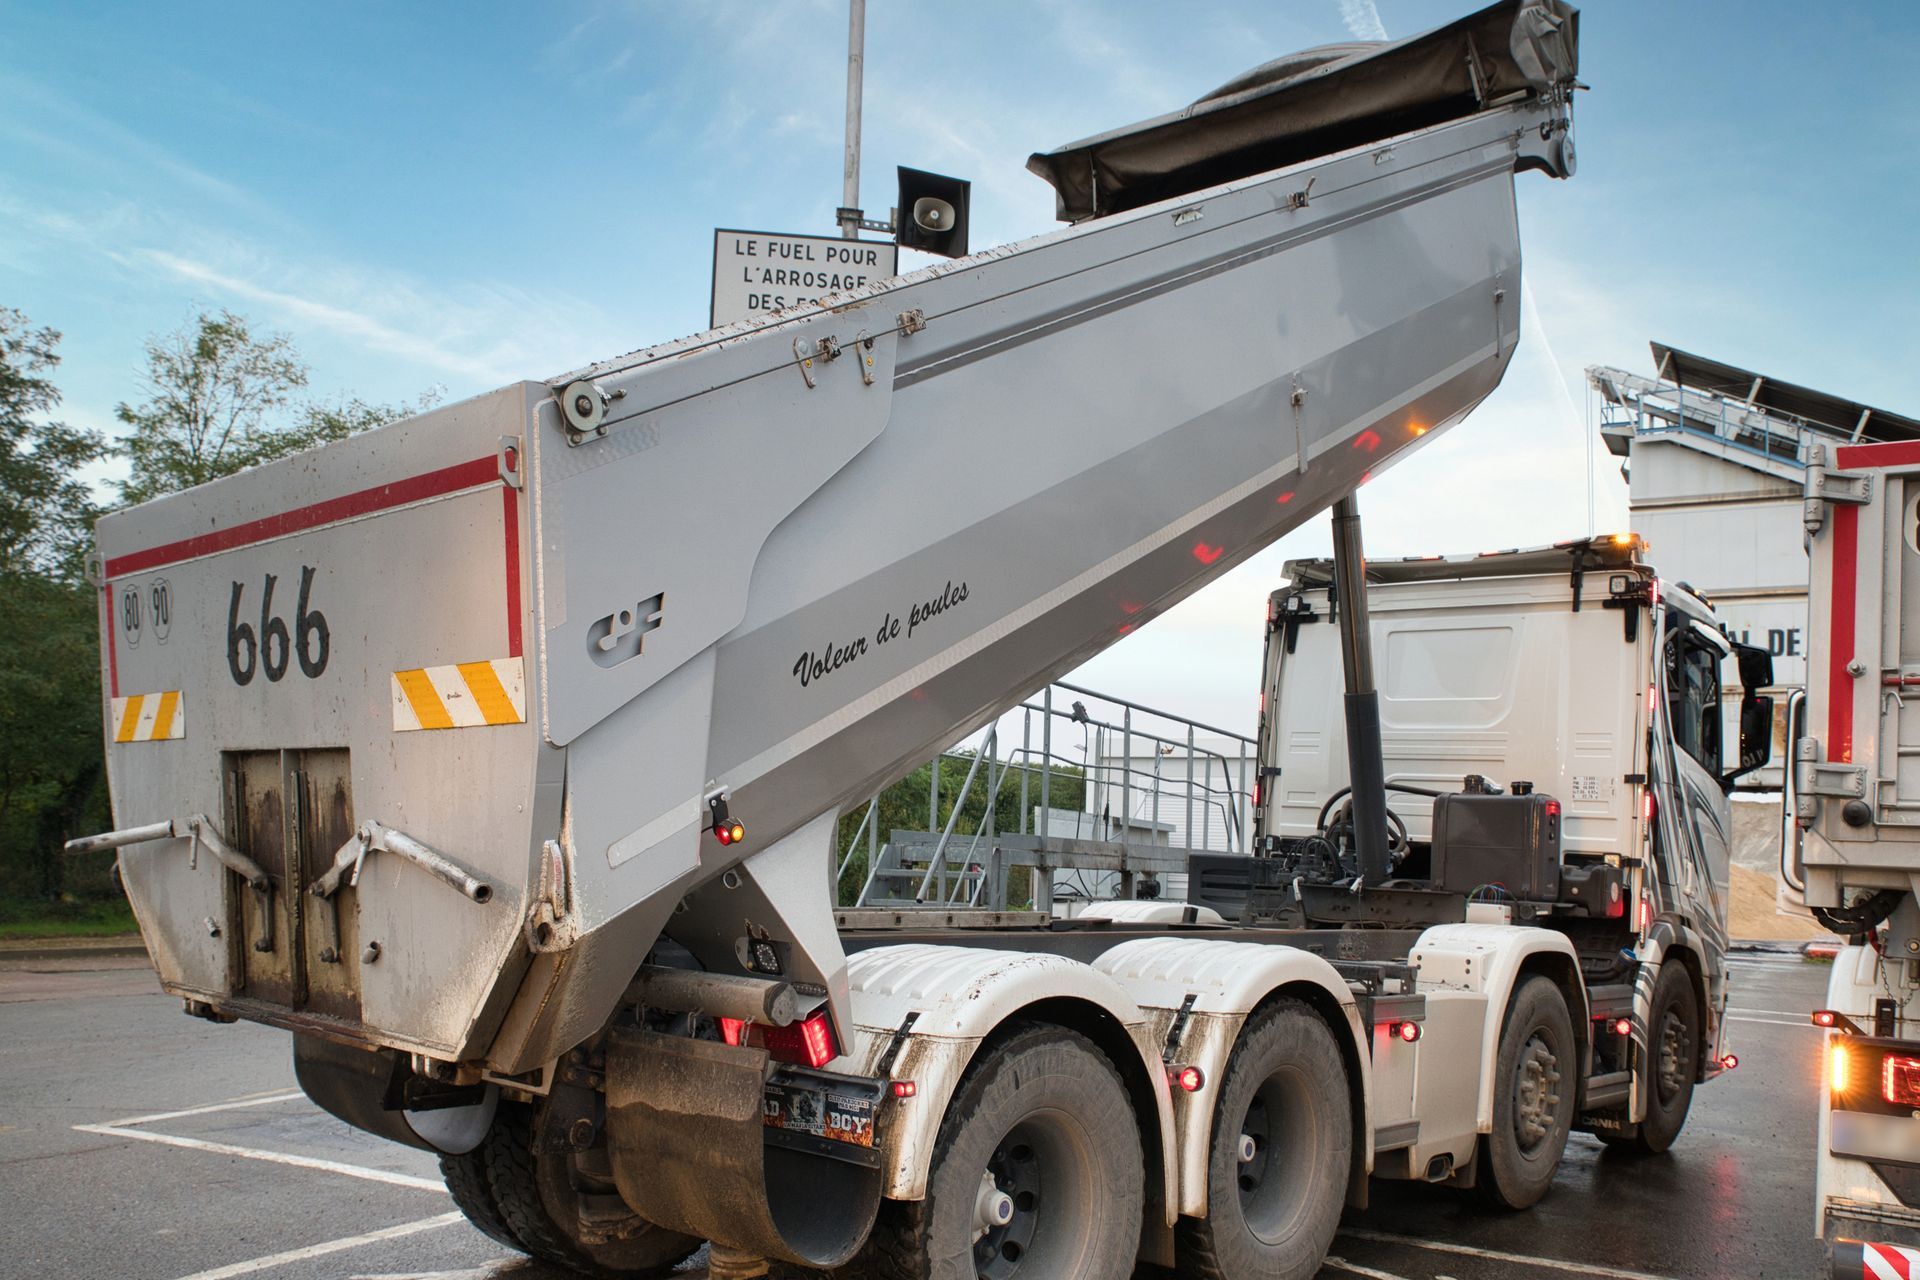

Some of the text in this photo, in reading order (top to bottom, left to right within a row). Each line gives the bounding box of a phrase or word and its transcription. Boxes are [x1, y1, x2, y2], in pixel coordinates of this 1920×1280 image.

[735, 239, 877, 266] LE FUEL POUR
[748, 293, 785, 310] DES
[125, 591, 140, 632] 80
[153, 585, 169, 627] 90
[227, 564, 330, 687] 666
[792, 580, 970, 688] Voleur de poules
[1767, 628, 1801, 657] DE
[830, 1111, 869, 1134] BOY
